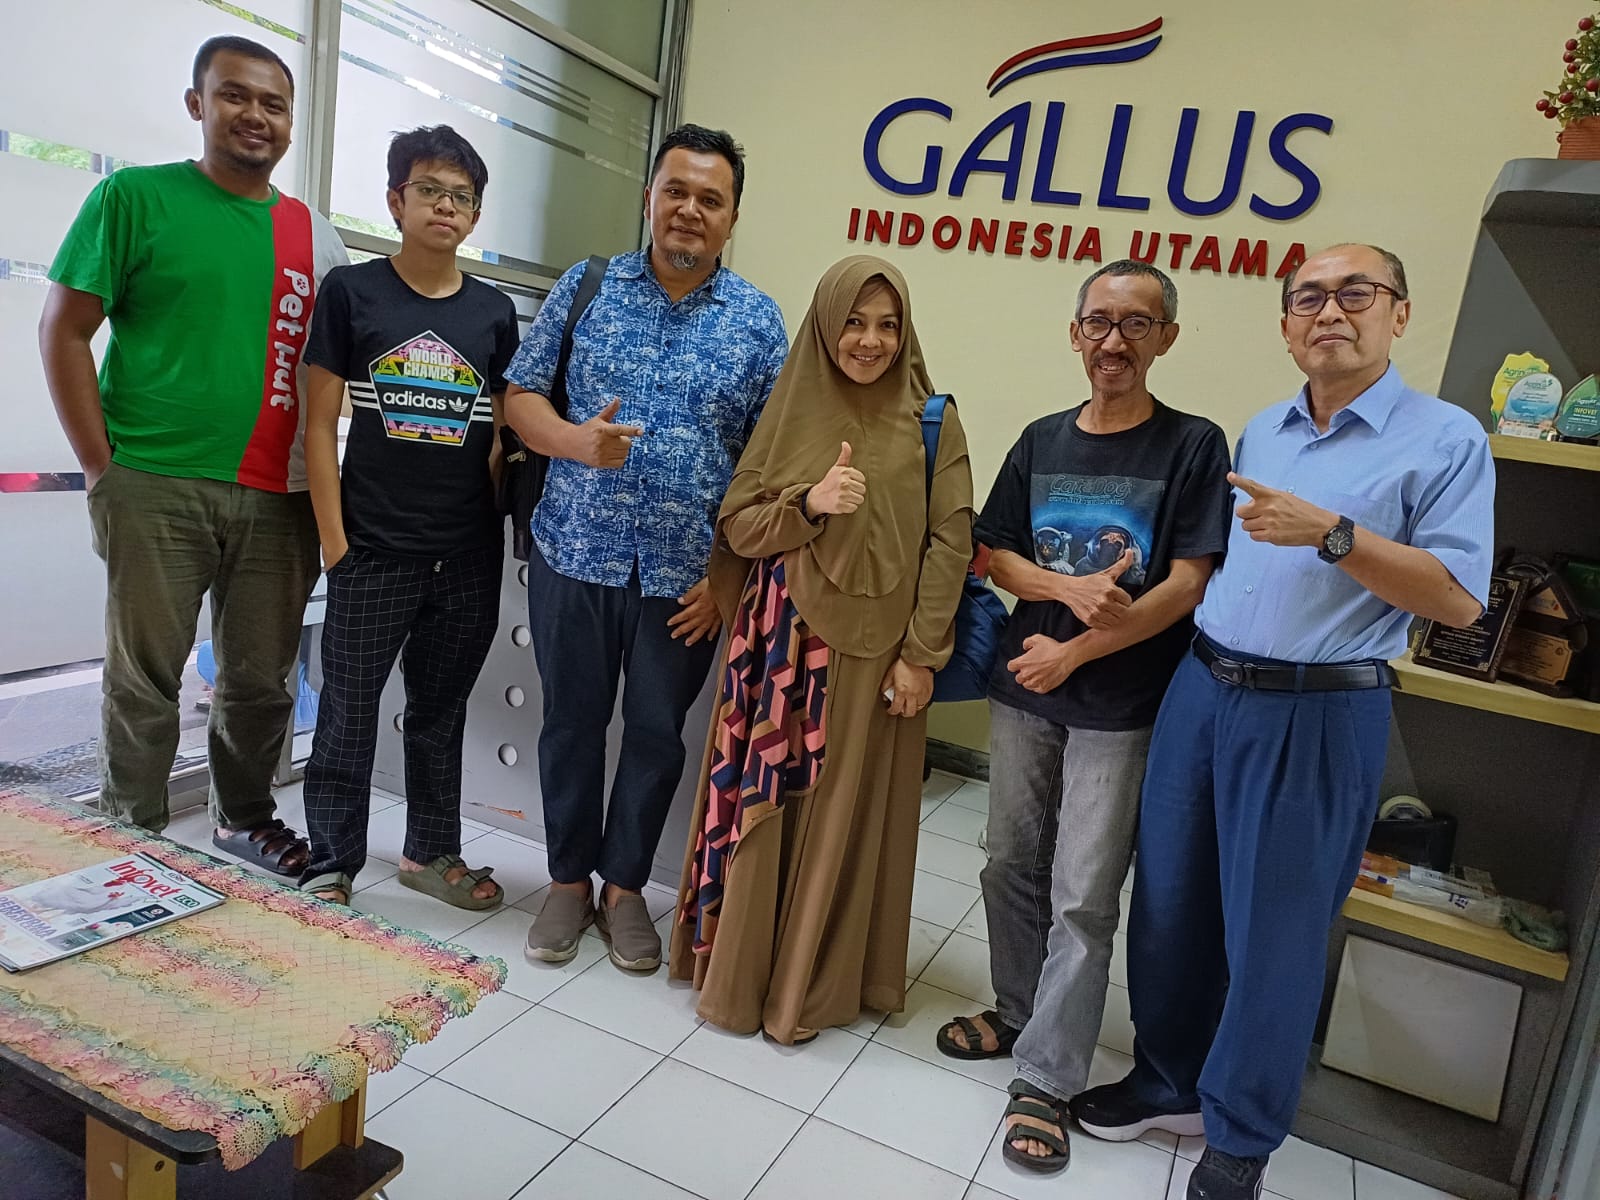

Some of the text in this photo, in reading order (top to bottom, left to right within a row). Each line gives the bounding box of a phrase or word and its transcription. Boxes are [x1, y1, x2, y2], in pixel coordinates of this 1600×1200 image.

[863, 97, 1334, 221] GALLUS
[847, 207, 1102, 263] INDONESIA
[270, 267, 311, 412] Pet Hut
[408, 348, 452, 367] WORLD
[403, 361, 456, 382] CHAMPS
[382, 390, 448, 411] adidas
[108, 860, 184, 898] Infovet
